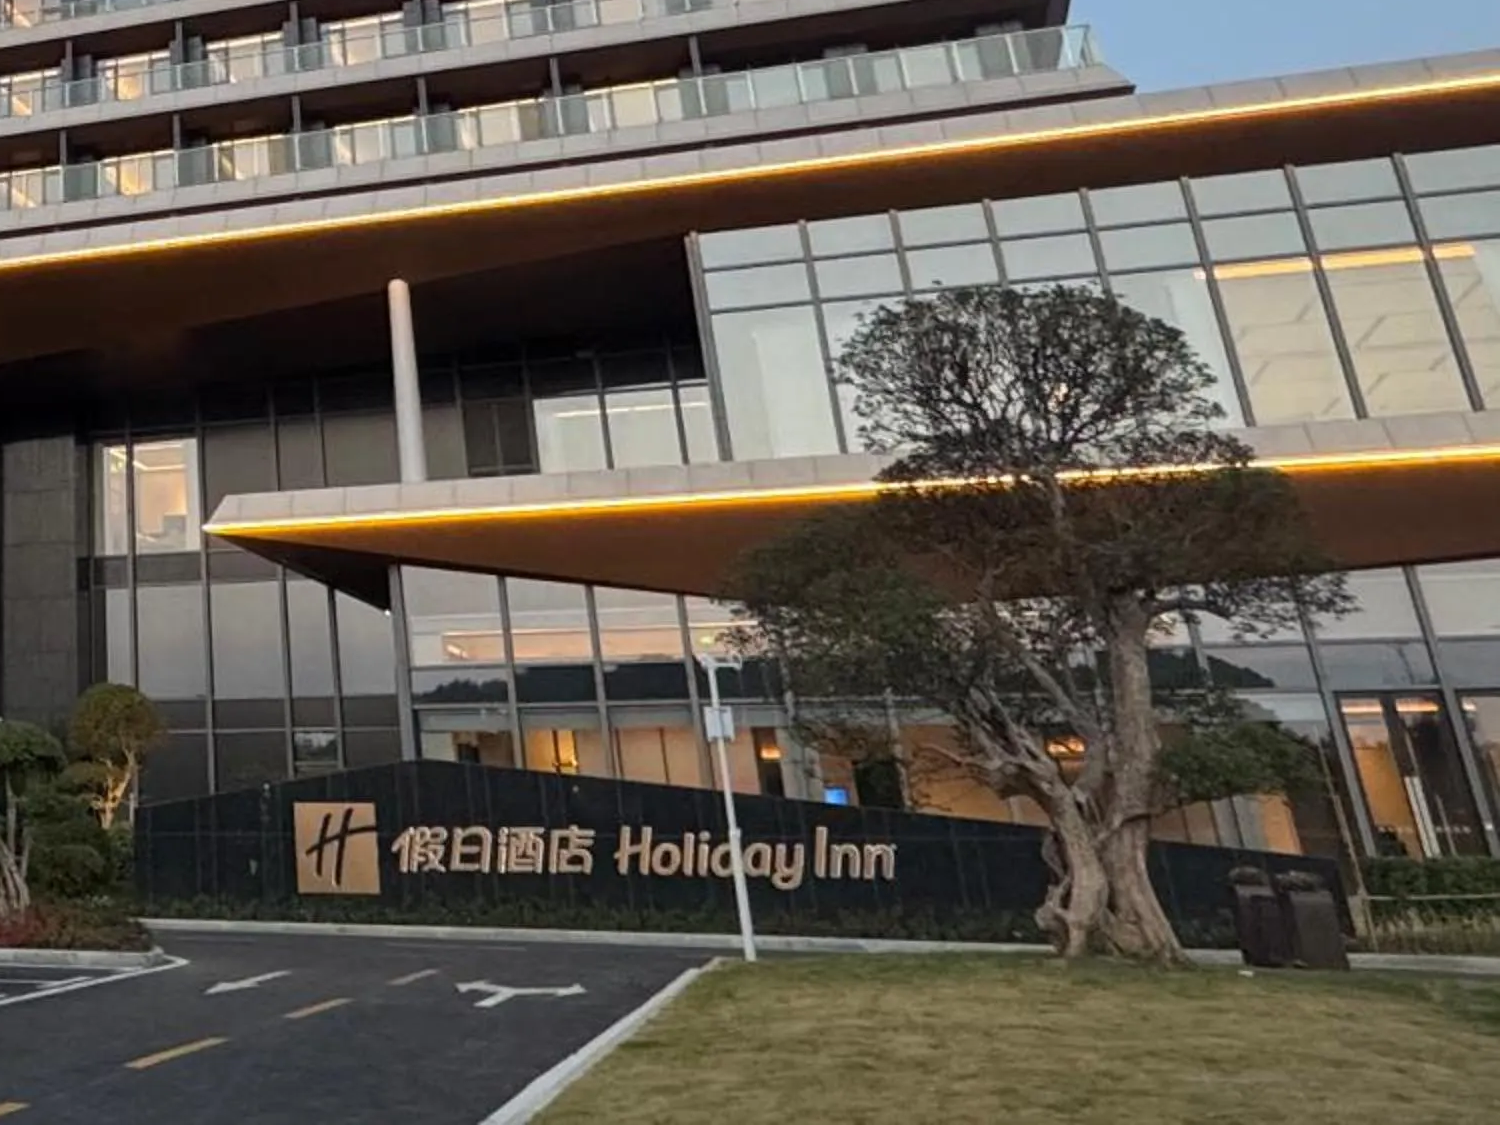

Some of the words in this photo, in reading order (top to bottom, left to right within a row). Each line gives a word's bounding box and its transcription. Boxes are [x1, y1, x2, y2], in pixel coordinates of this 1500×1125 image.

[391, 824, 597, 876] 假日酒店
[814, 825, 897, 880] Inn
